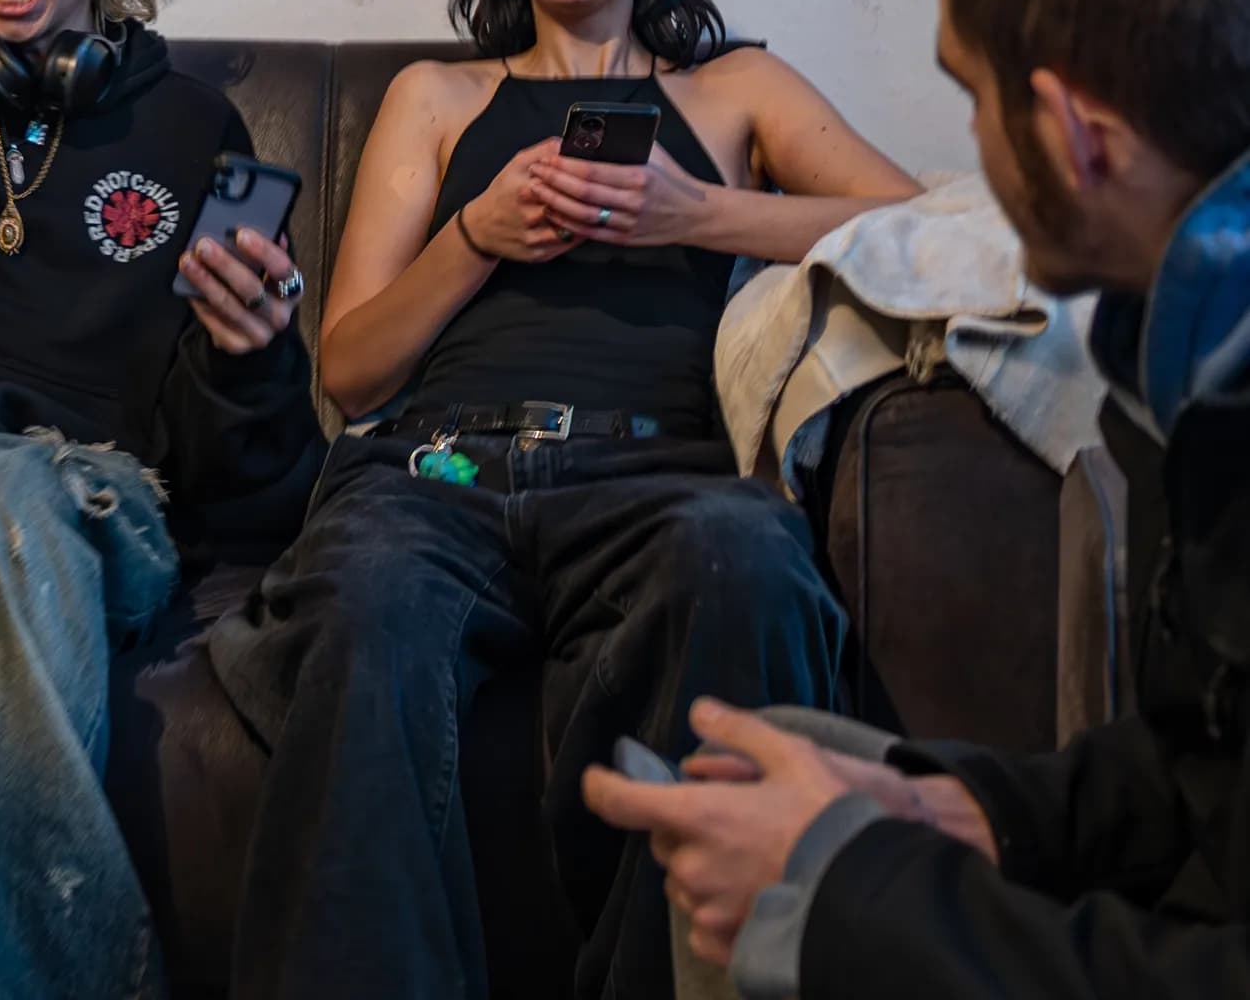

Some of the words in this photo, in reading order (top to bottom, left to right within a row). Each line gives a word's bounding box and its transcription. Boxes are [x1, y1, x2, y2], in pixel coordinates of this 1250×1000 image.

[93, 171, 131, 198] HOT
[131, 174, 179, 211] CHILI
[83, 195, 107, 240] RED
